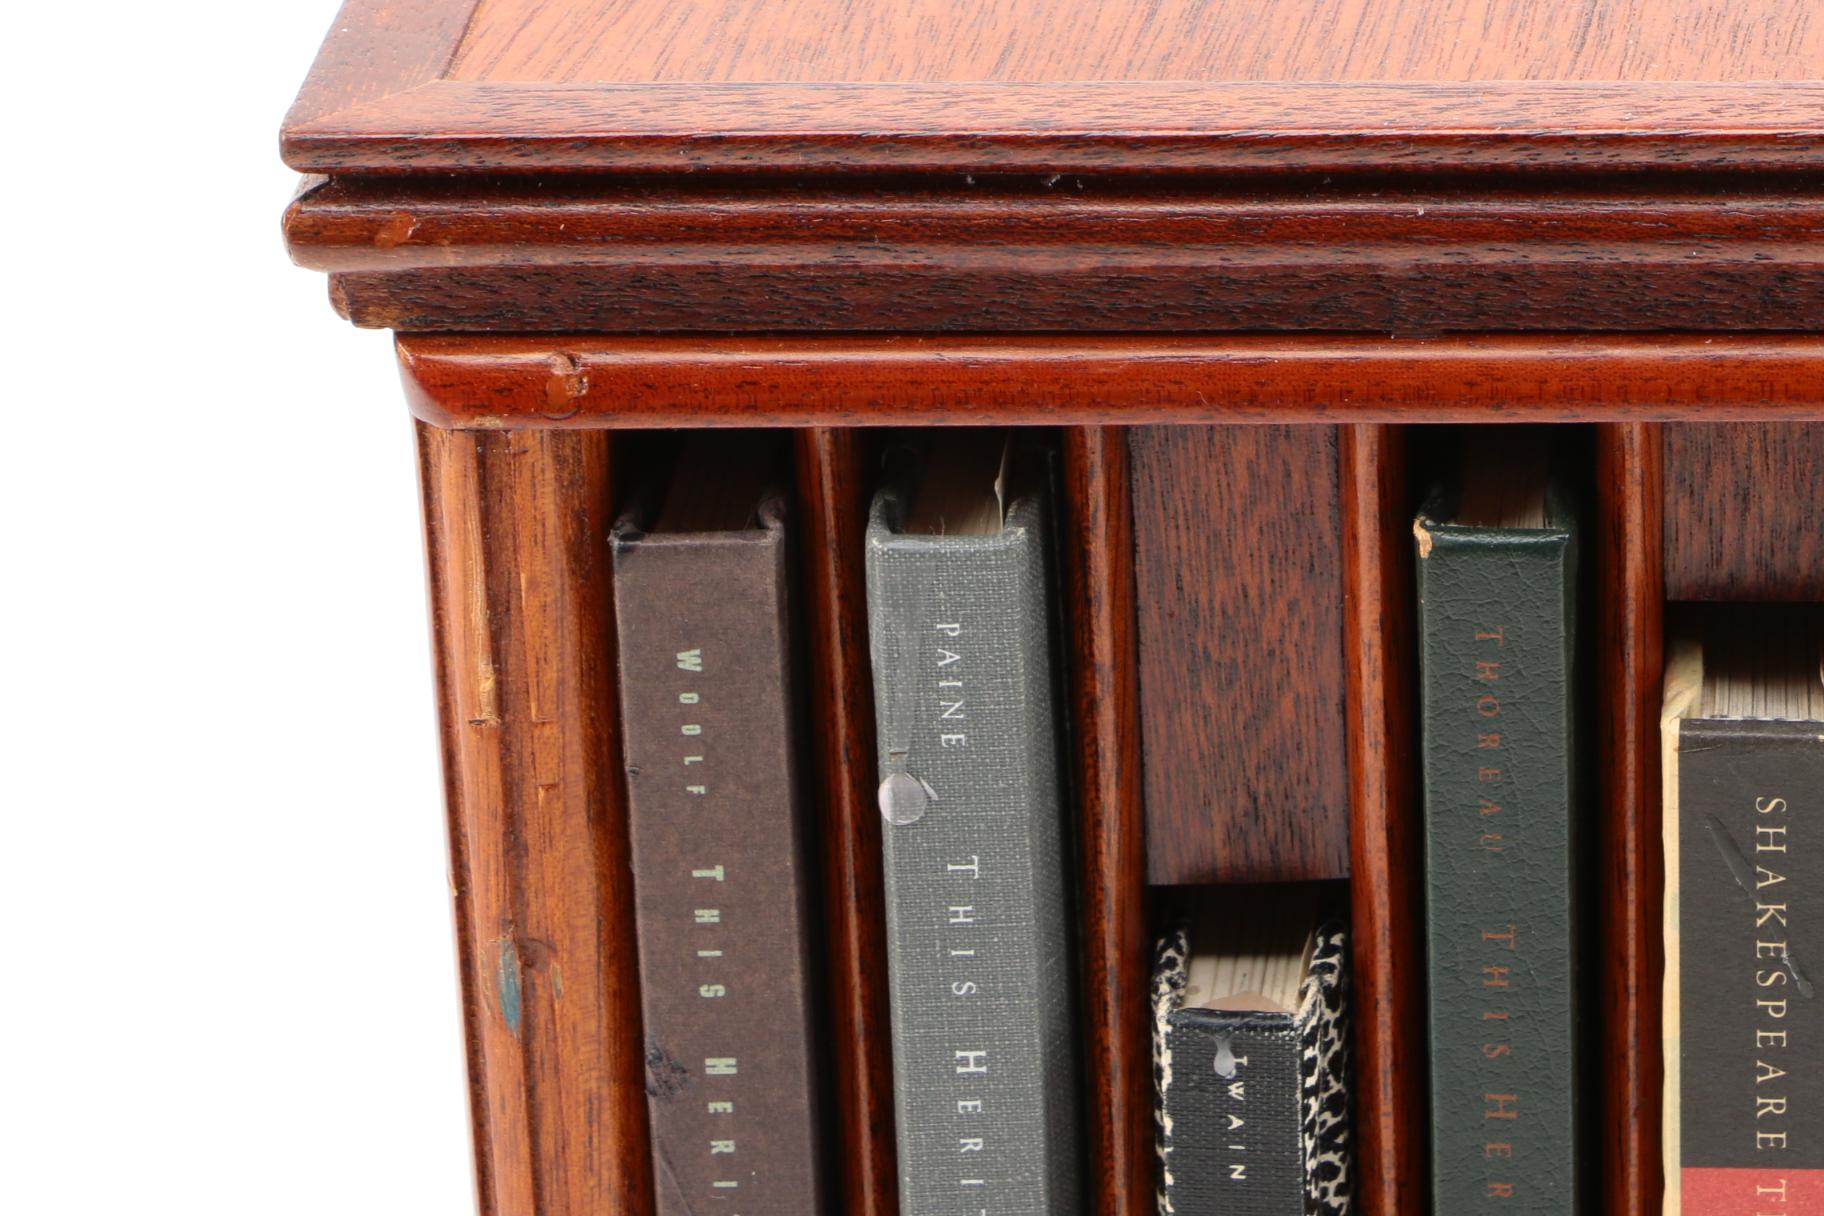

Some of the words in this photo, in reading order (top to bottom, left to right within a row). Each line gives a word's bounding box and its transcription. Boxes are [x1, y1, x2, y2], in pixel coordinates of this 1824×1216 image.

[936, 623, 966, 748] PAINE
[1475, 626, 1504, 852] THOREAU
[676, 648, 706, 795] WOOLF
[691, 864, 726, 998] THIS
[947, 855, 980, 996] THIS
[1481, 923, 1517, 1059] THIS
[1755, 796, 1787, 1150] SHAKESPEARE
[955, 1050, 987, 1216] HERI
[1484, 1093, 1519, 1198] HER
[1756, 1179, 1787, 1216] T
